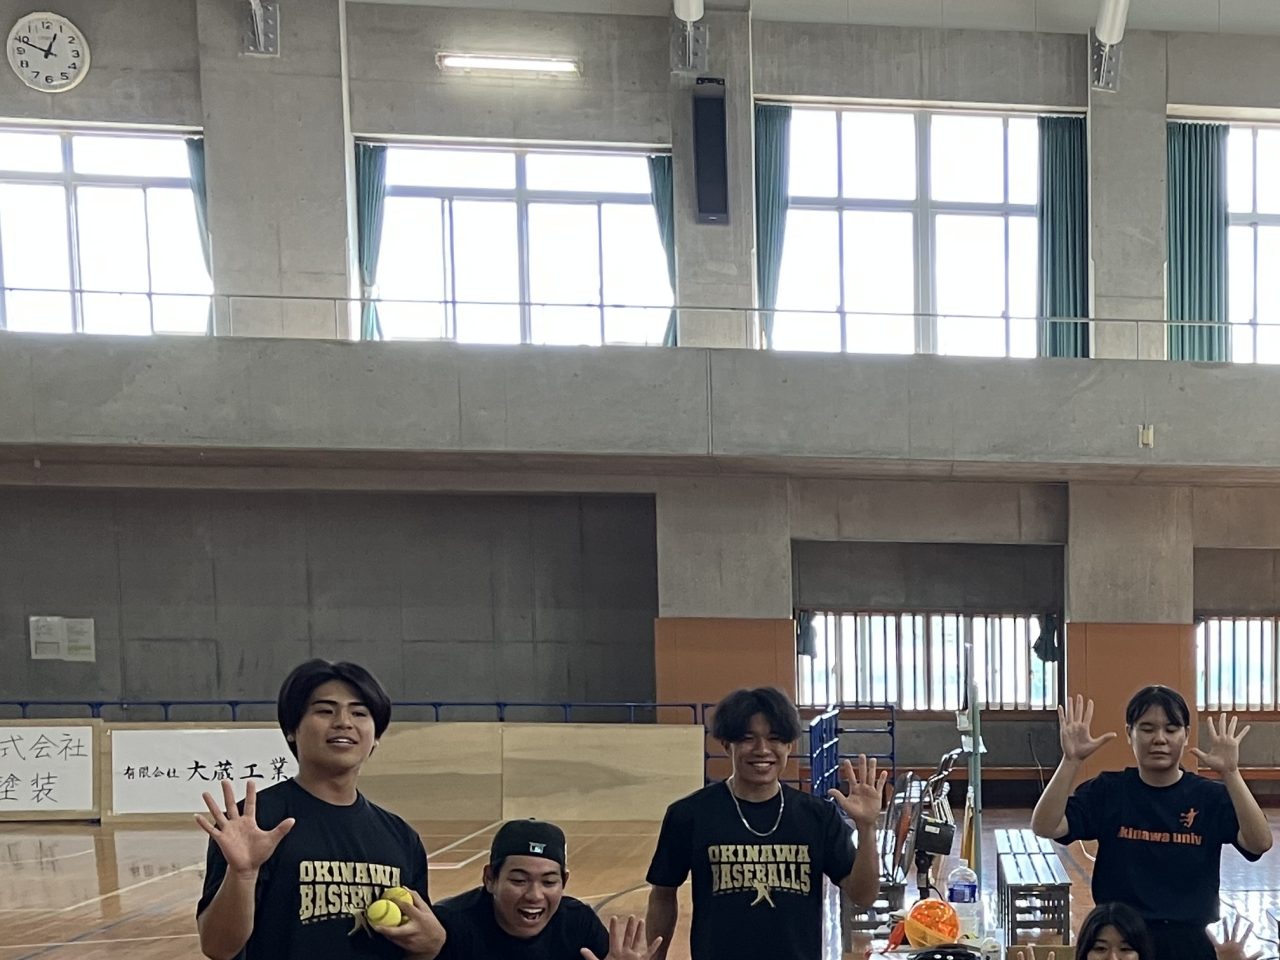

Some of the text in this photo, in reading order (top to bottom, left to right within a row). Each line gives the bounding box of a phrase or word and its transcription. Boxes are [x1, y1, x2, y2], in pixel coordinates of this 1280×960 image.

[123, 765, 180, 780] 有限会社
[1118, 826, 1170, 842] kinawa
[708, 844, 811, 862] OKINAWA
[300, 860, 401, 887] OKINAWA
[711, 863, 811, 893] BASEBALL5
[300, 883, 382, 921] BASEBA
